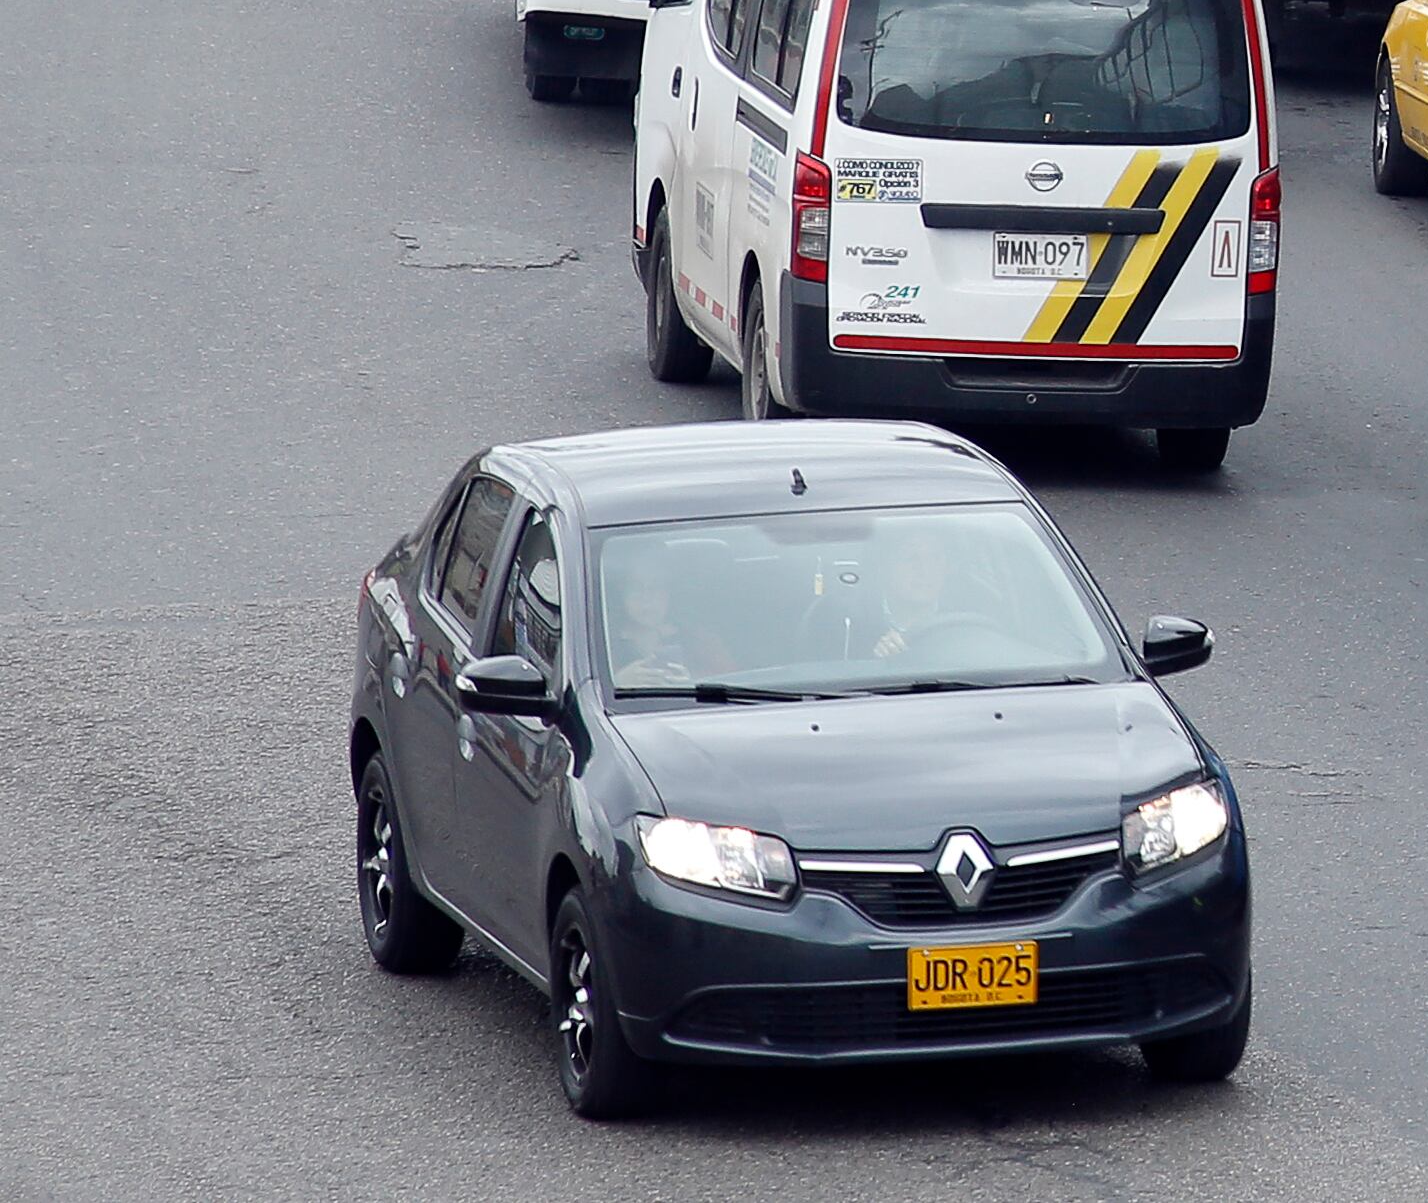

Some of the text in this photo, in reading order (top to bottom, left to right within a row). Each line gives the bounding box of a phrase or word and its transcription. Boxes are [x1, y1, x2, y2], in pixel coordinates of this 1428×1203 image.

[837, 170, 880, 178] MARQUE
[912, 179, 919, 188] 3
[884, 285, 920, 298] 241
